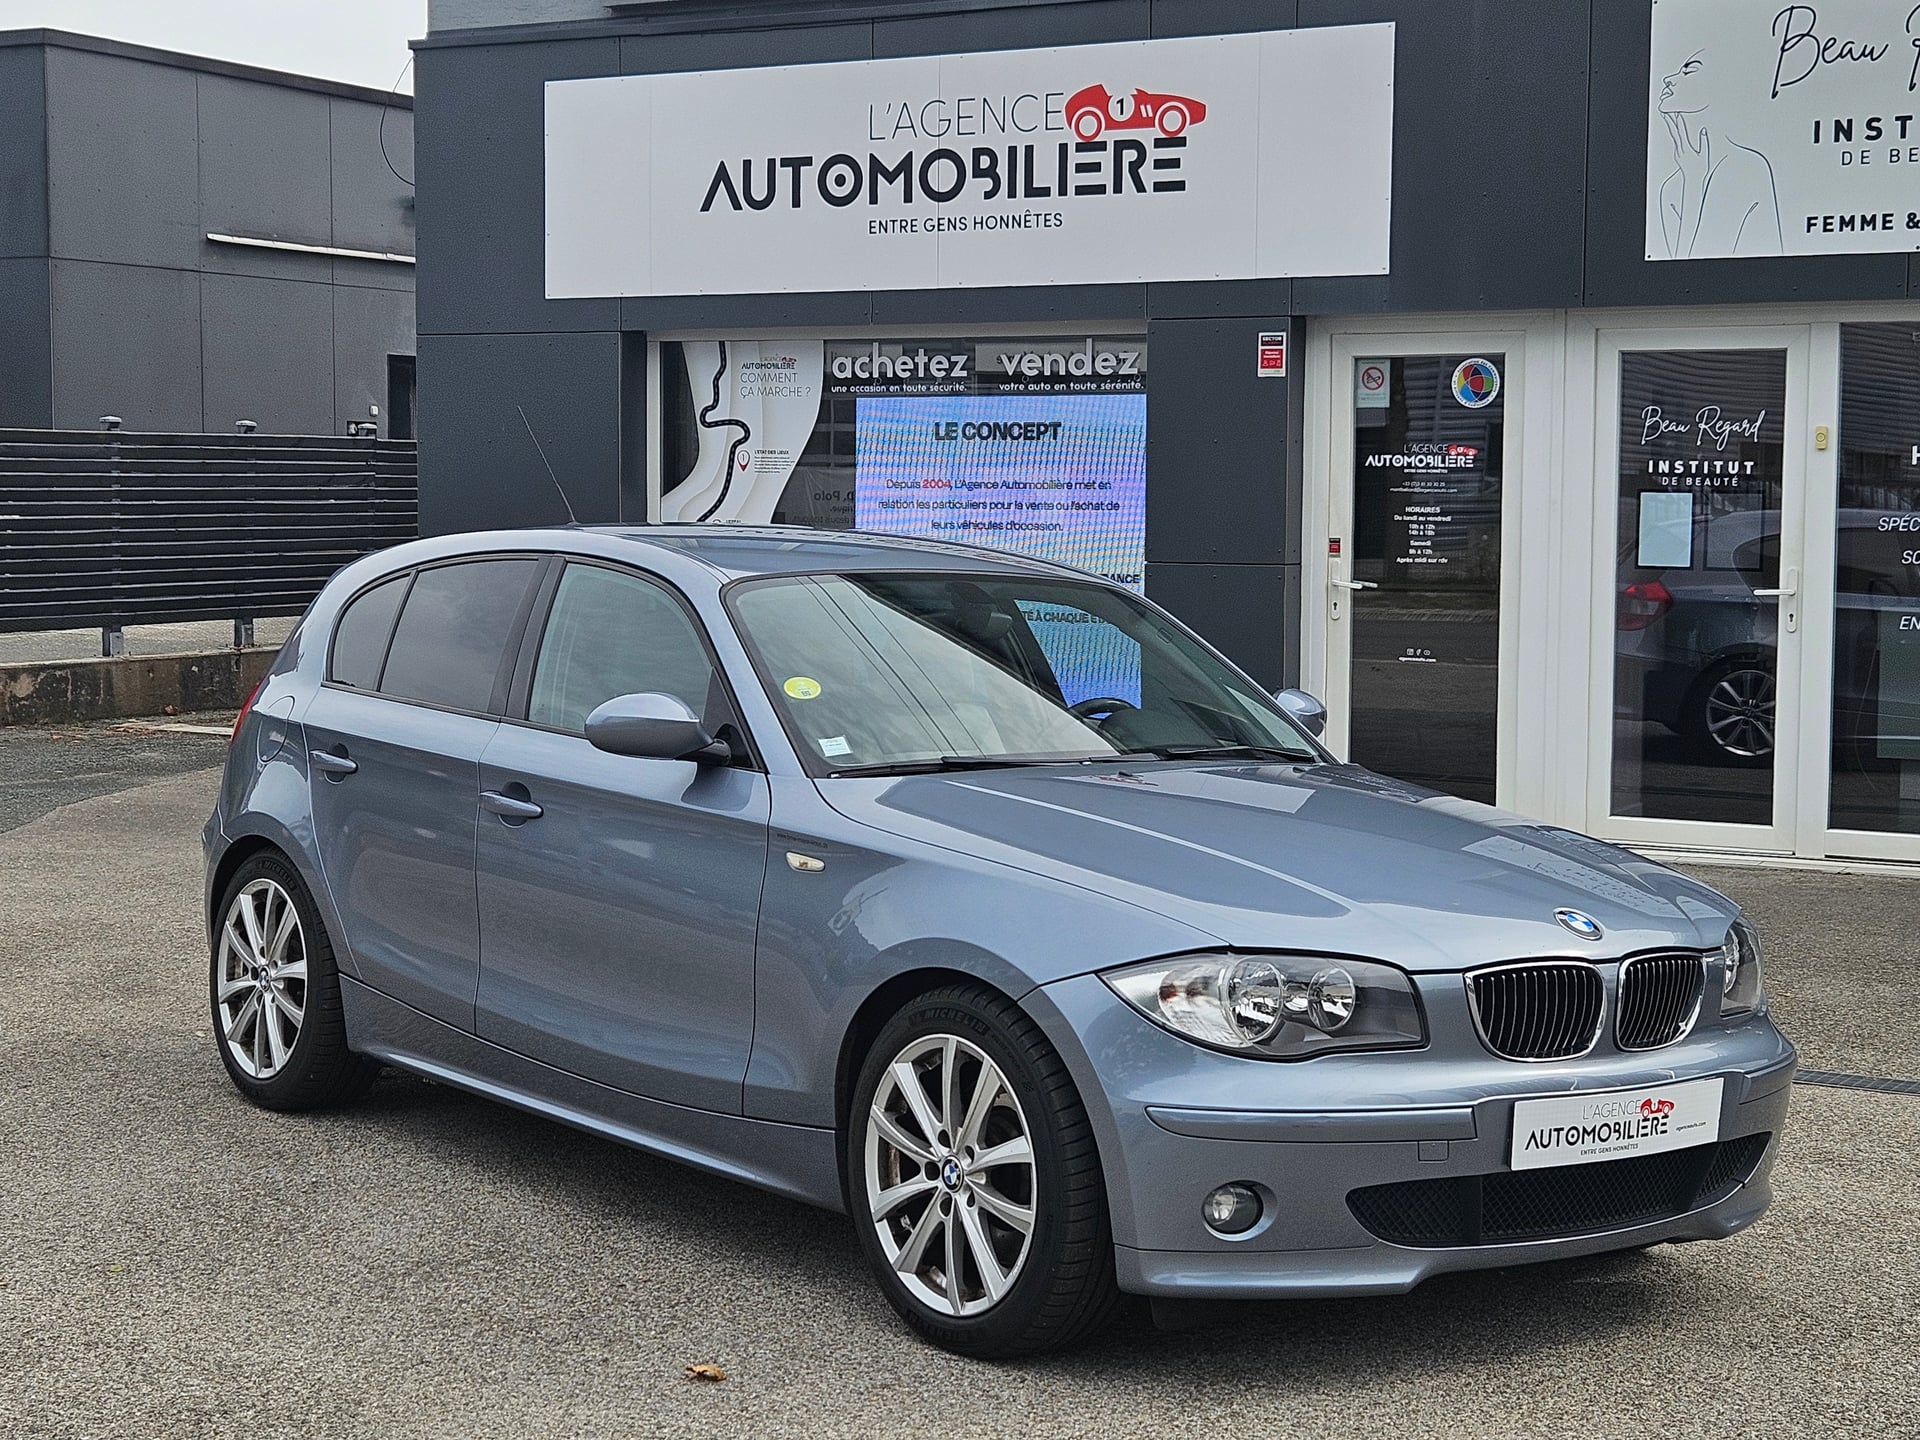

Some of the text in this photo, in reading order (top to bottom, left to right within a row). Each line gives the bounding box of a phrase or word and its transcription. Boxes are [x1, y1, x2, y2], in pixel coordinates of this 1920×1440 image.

[1771, 5, 1889, 99] Beau
[869, 92, 1064, 141] L'AGENCE
[1814, 115, 1913, 144] INST
[1841, 147, 1920, 166] DE BE
[868, 209, 1063, 235] ENTRE GENS HONNÊTES
[1806, 213, 1894, 234] FEMME
[832, 342, 968, 378] achetez
[1000, 338, 1140, 376] vendez
[740, 372, 798, 384] COMMENT
[831, 381, 968, 393] une occasion en toute sécurité.
[999, 379, 1145, 391] votre auto en toute sérénité.
[740, 386, 755, 399] ÇA
[757, 386, 802, 398] MARCHE
[934, 421, 1062, 441] LE CONCEPT
[1641, 405, 1766, 451] Beau Regard
[1403, 443, 1449, 455] L'AGENCE
[1648, 460, 1755, 475] INSTITUT
[886, 479, 1112, 492] Depuis 2004, L'Agence Automobilière met en
[1662, 475, 1739, 487] DE BEAUTÉ
[878, 500, 915, 509] relation
[916, 500, 931, 509] les
[932, 500, 987, 511] particuliers
[988, 502, 1013, 511] pour
[1025, 502, 1055, 510] vente
[1055, 502, 1069, 511] ou
[1105, 501, 1120, 511] de
[931, 521, 1064, 531] leurs véhicules d'occasion.
[924, 1006, 988, 1034] MICHELIN
[1582, 1100, 1642, 1120] L'AGENCE
